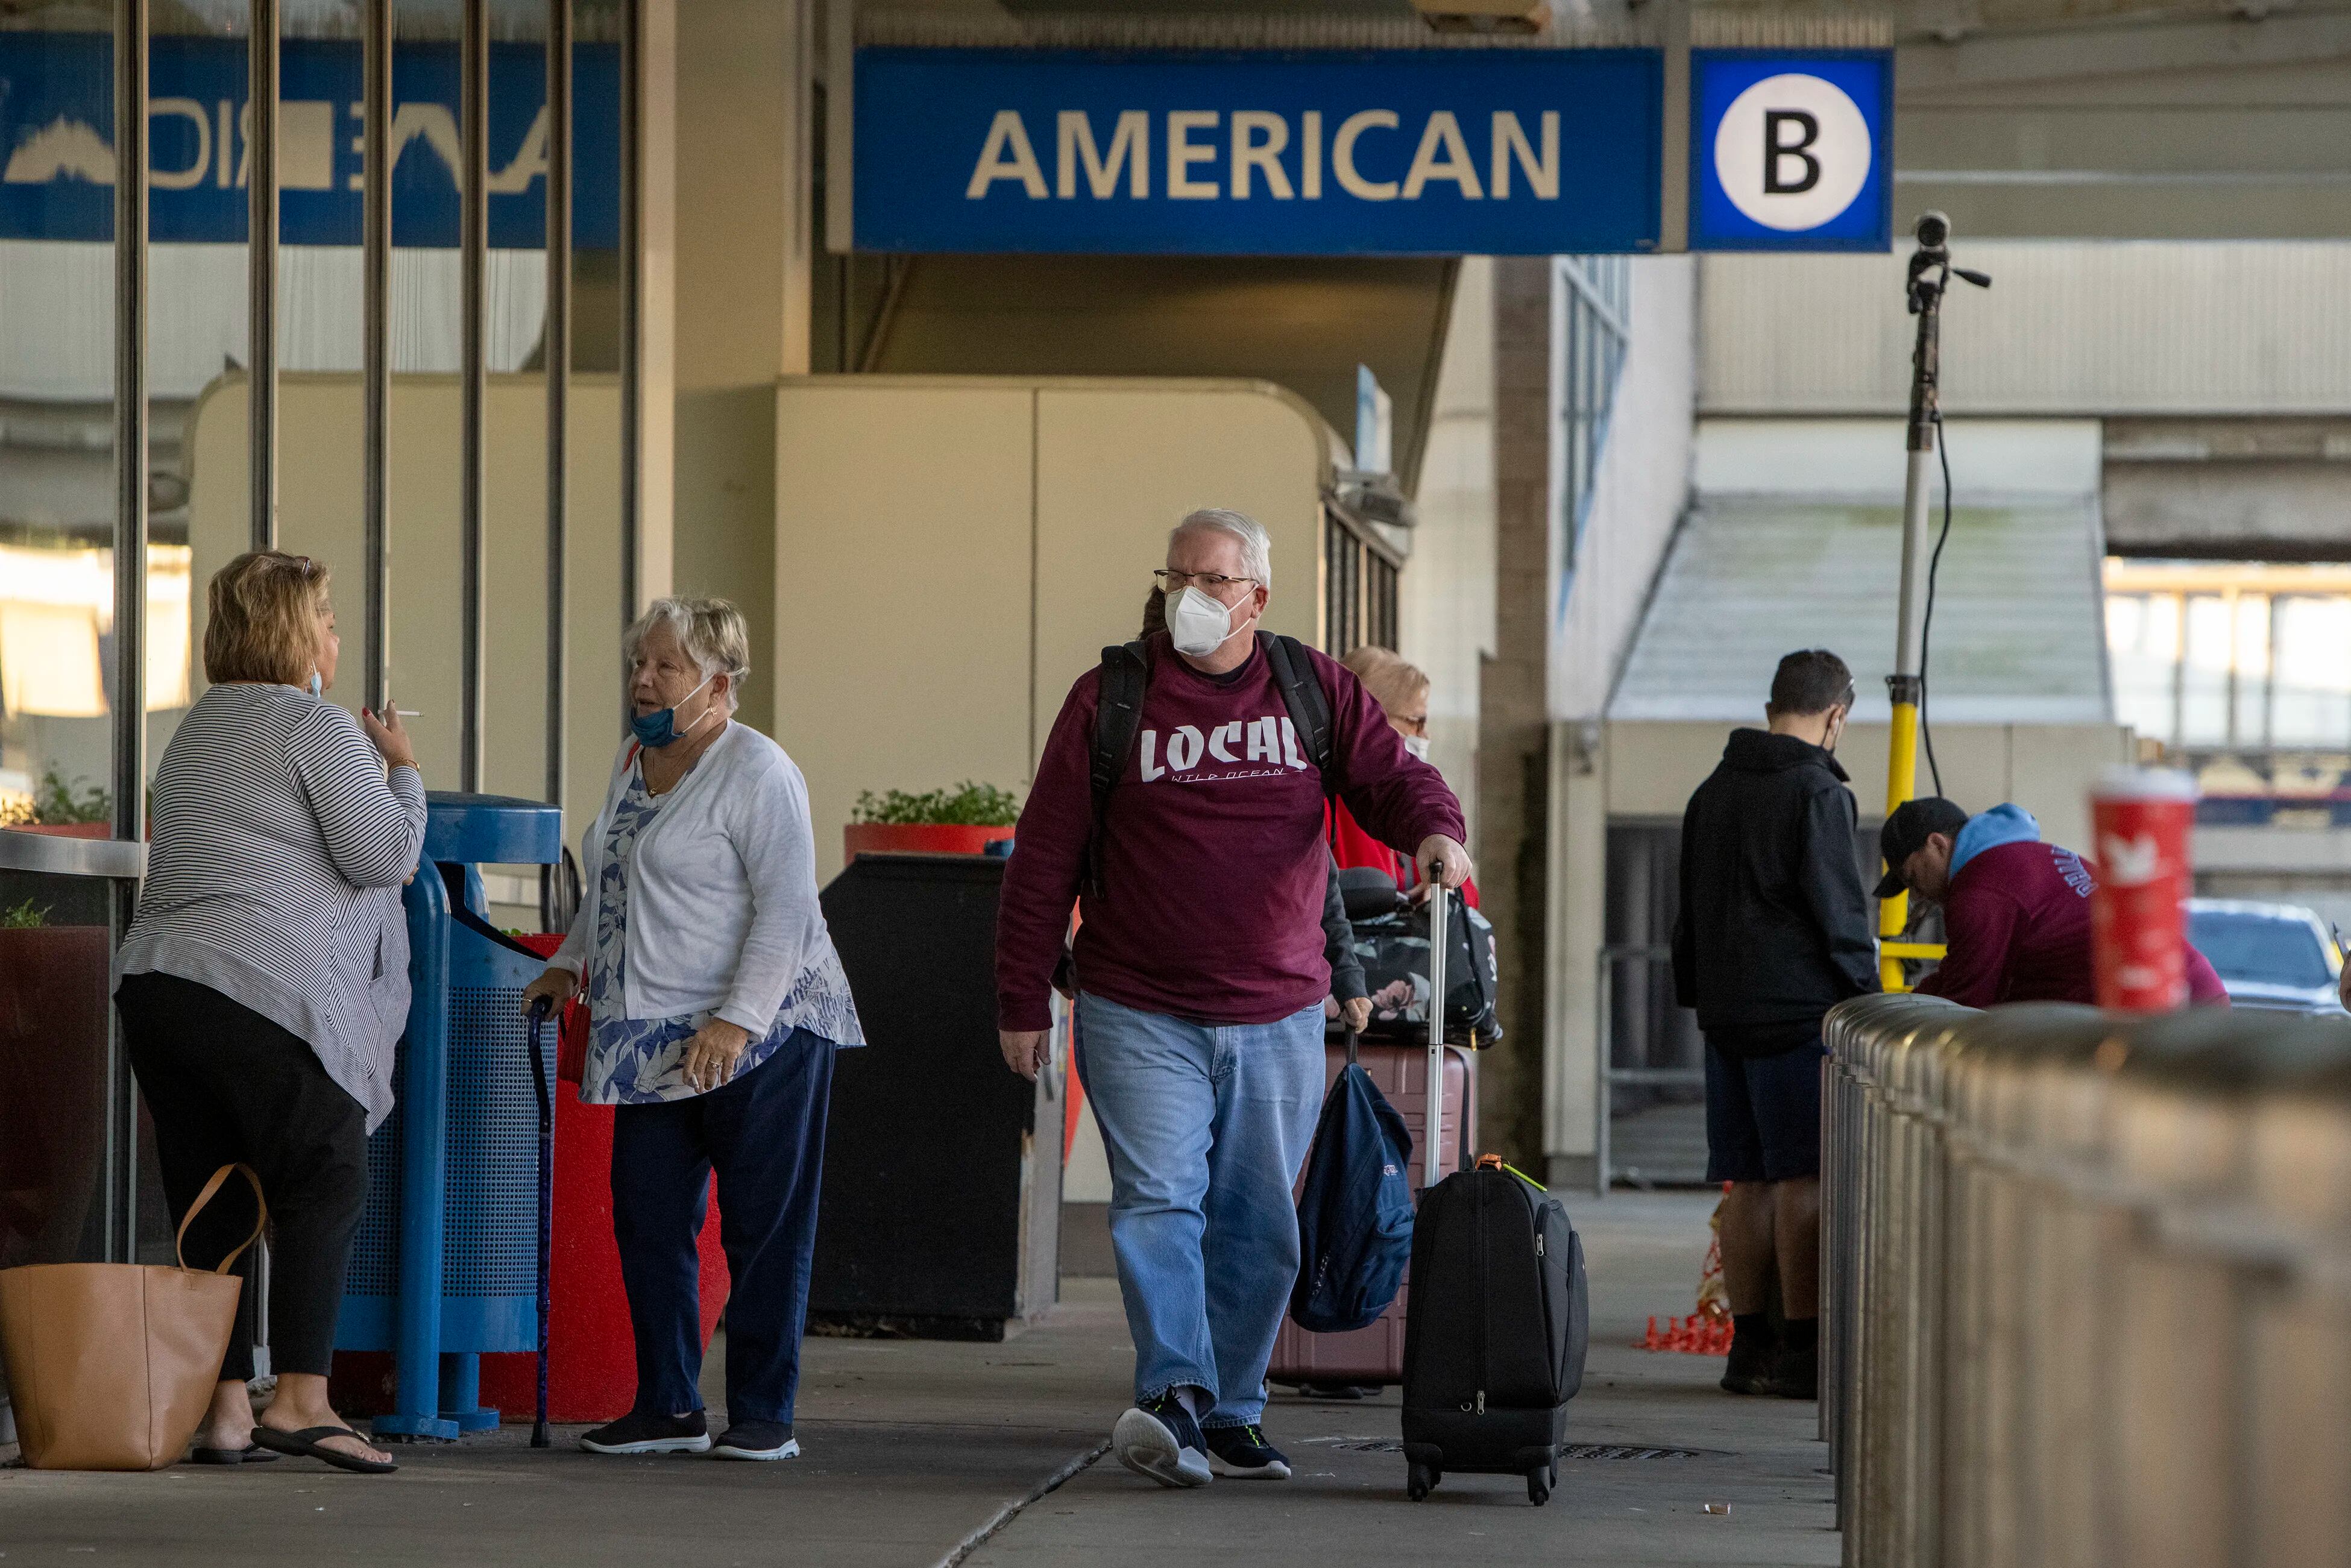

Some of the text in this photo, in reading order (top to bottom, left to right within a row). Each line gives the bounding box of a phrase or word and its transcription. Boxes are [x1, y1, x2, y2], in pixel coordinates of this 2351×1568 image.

[966, 109, 1560, 201] AMERICAN
[1763, 109, 1820, 194] B
[1141, 716, 1307, 782] LOCAL
[1171, 767, 1283, 782] WILD OCEAN
